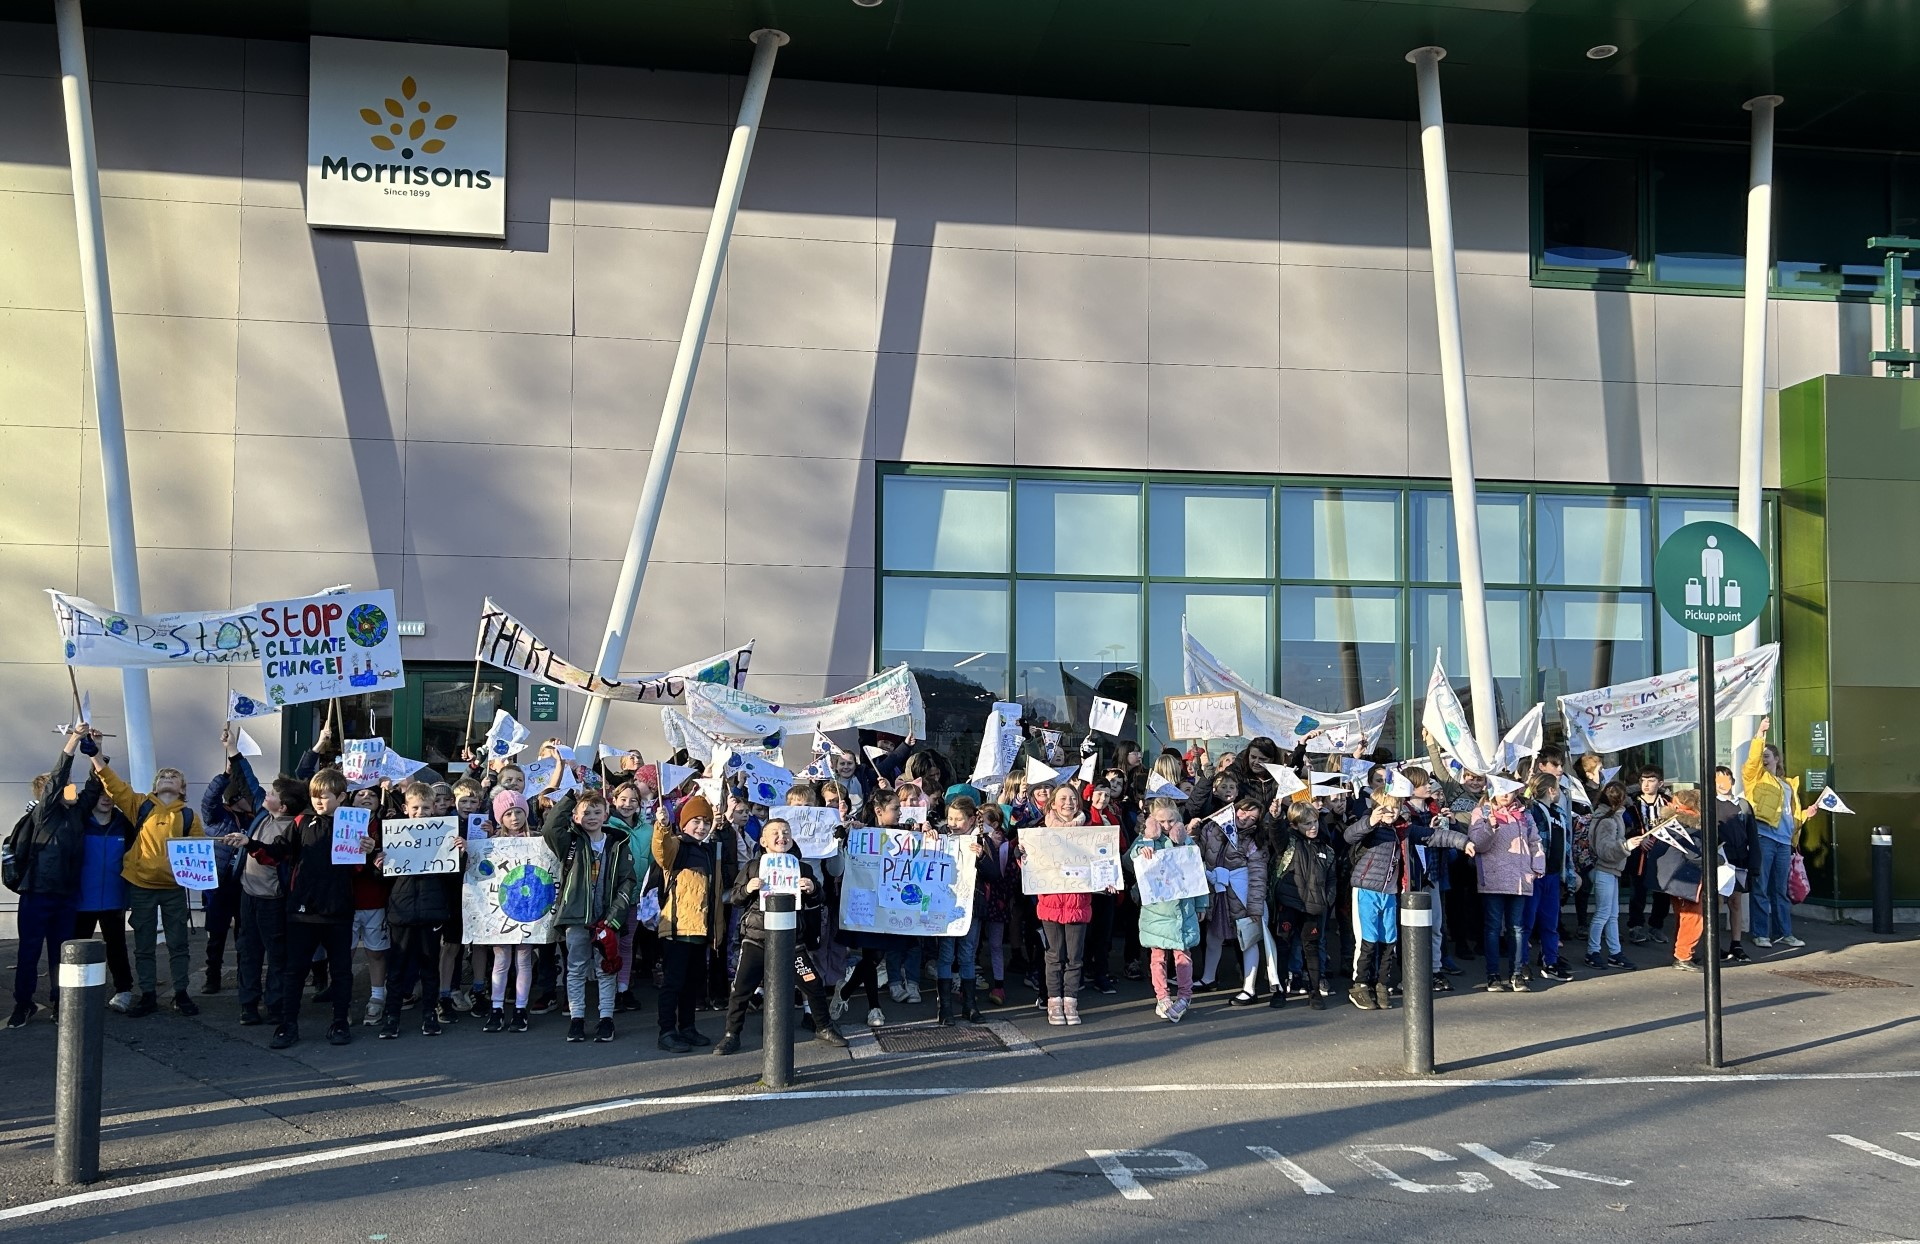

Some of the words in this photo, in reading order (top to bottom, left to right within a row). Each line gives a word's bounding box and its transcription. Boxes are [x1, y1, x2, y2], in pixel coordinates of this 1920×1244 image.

[321, 155, 491, 190] Morrisons
[383, 188, 408, 196] Since
[409, 189, 431, 198] 1899
[1684, 609, 1716, 623] Pickup
[1717, 611, 1742, 623] point
[265, 636, 347, 659] CLIMATE
[266, 656, 344, 681] CHANGE!
[340, 810, 368, 825] HELP
[385, 821, 445, 835] MONTH
[176, 843, 212, 855] HELP
[849, 832, 888, 855] HELP
[892, 833, 930, 859] SAVE
[420, 859, 457, 873] CUT
[767, 857, 798, 869] HELP
[883, 857, 950, 883] PLANET
[175, 869, 215, 882] CHANGE
[1084, 1138, 1635, 1201] PICK
